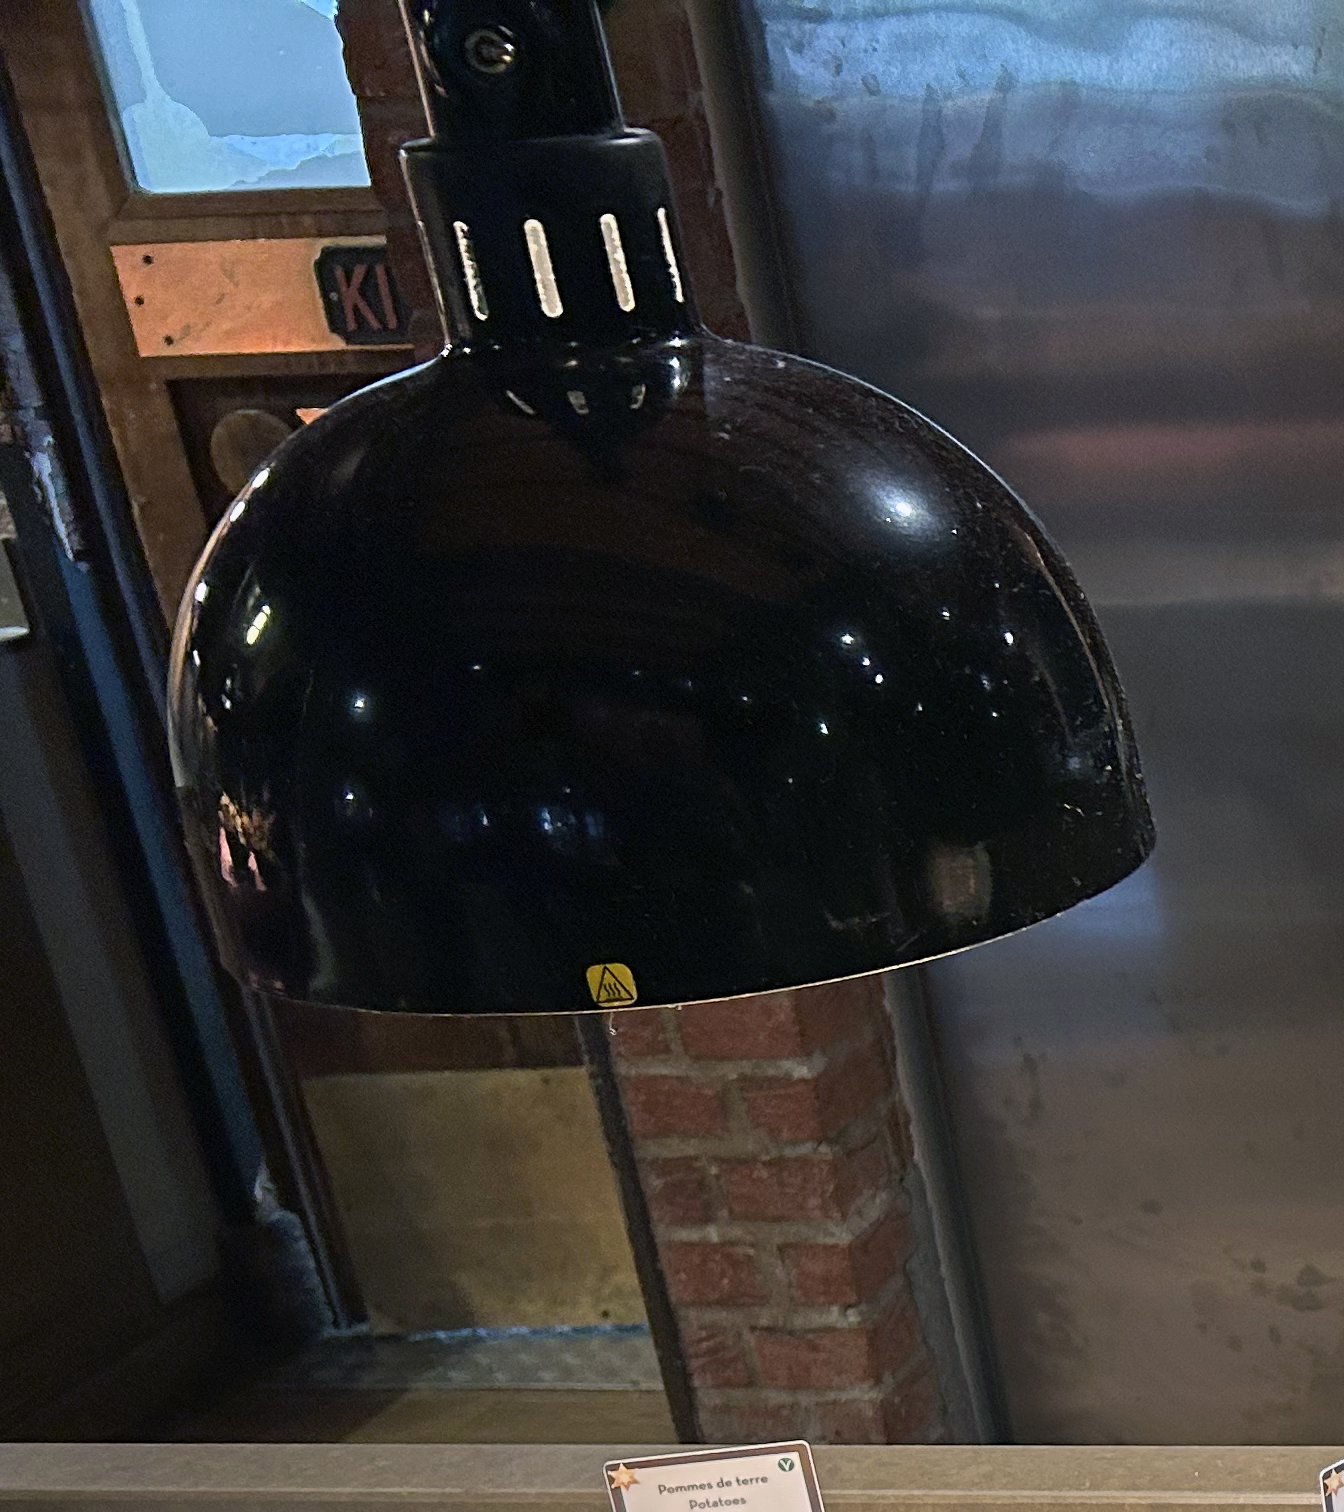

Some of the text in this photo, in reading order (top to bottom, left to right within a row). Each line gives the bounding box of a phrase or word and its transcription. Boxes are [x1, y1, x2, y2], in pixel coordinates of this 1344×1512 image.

[658, 1475, 769, 1495] Pommes de terre
[689, 1496, 747, 1510] Potatoes
